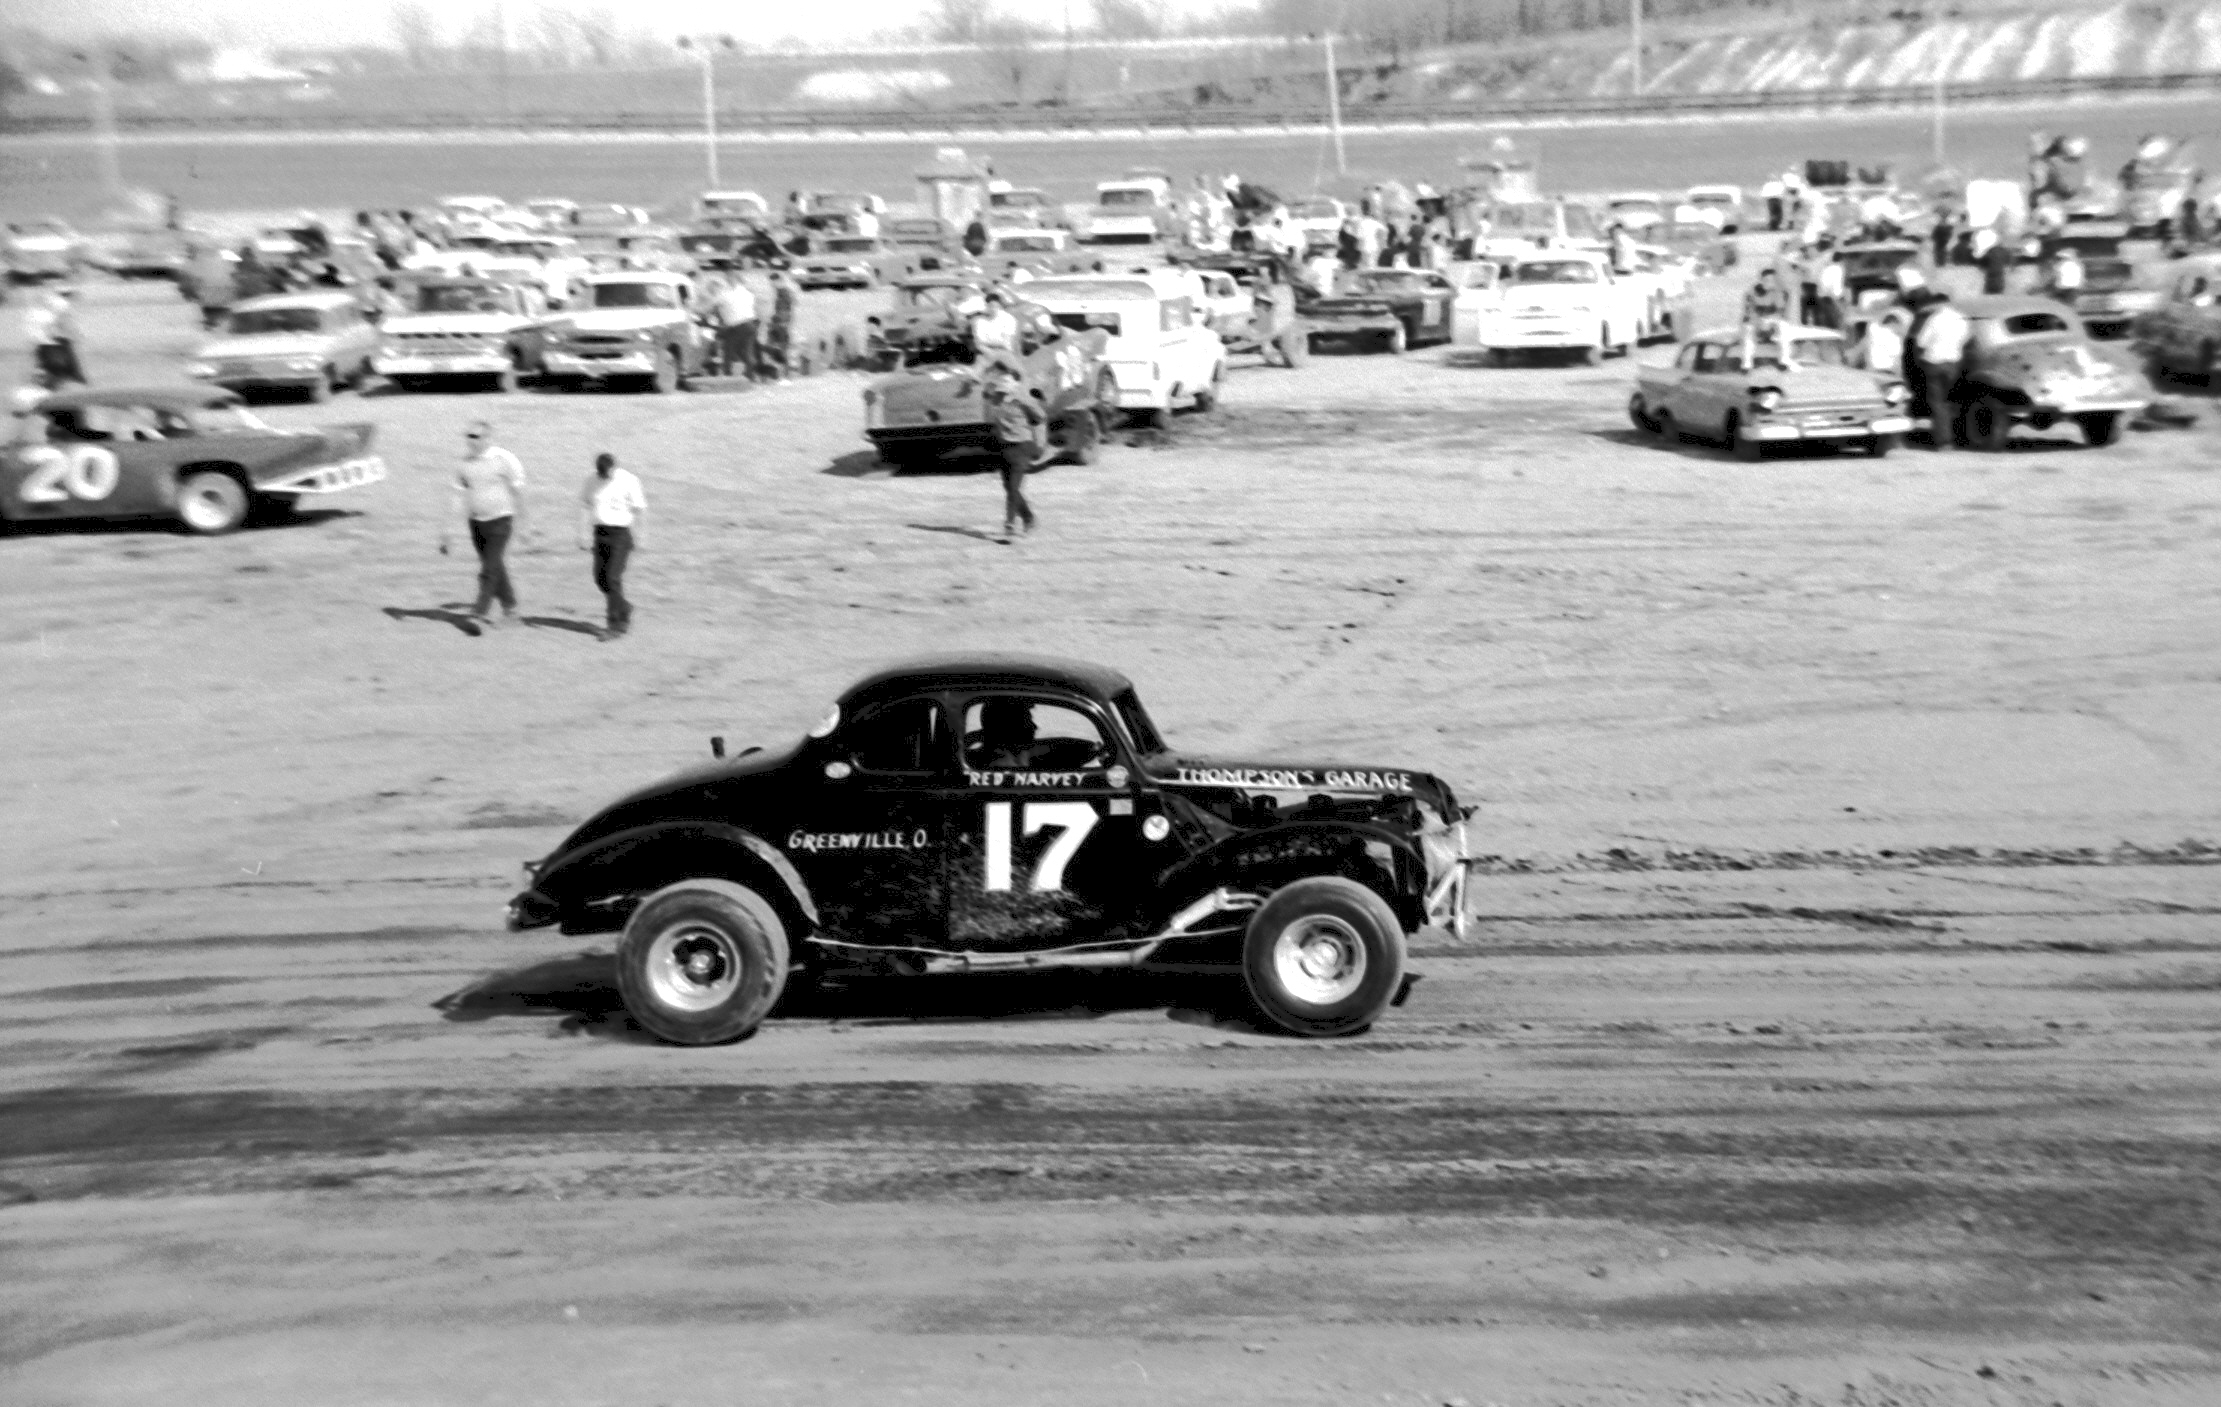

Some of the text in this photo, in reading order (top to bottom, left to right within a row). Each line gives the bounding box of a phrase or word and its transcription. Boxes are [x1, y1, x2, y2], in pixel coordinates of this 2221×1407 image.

[19, 443, 119, 502] 20
[1325, 770, 1413, 791] GARAGE
[985, 802, 1099, 890] 17
